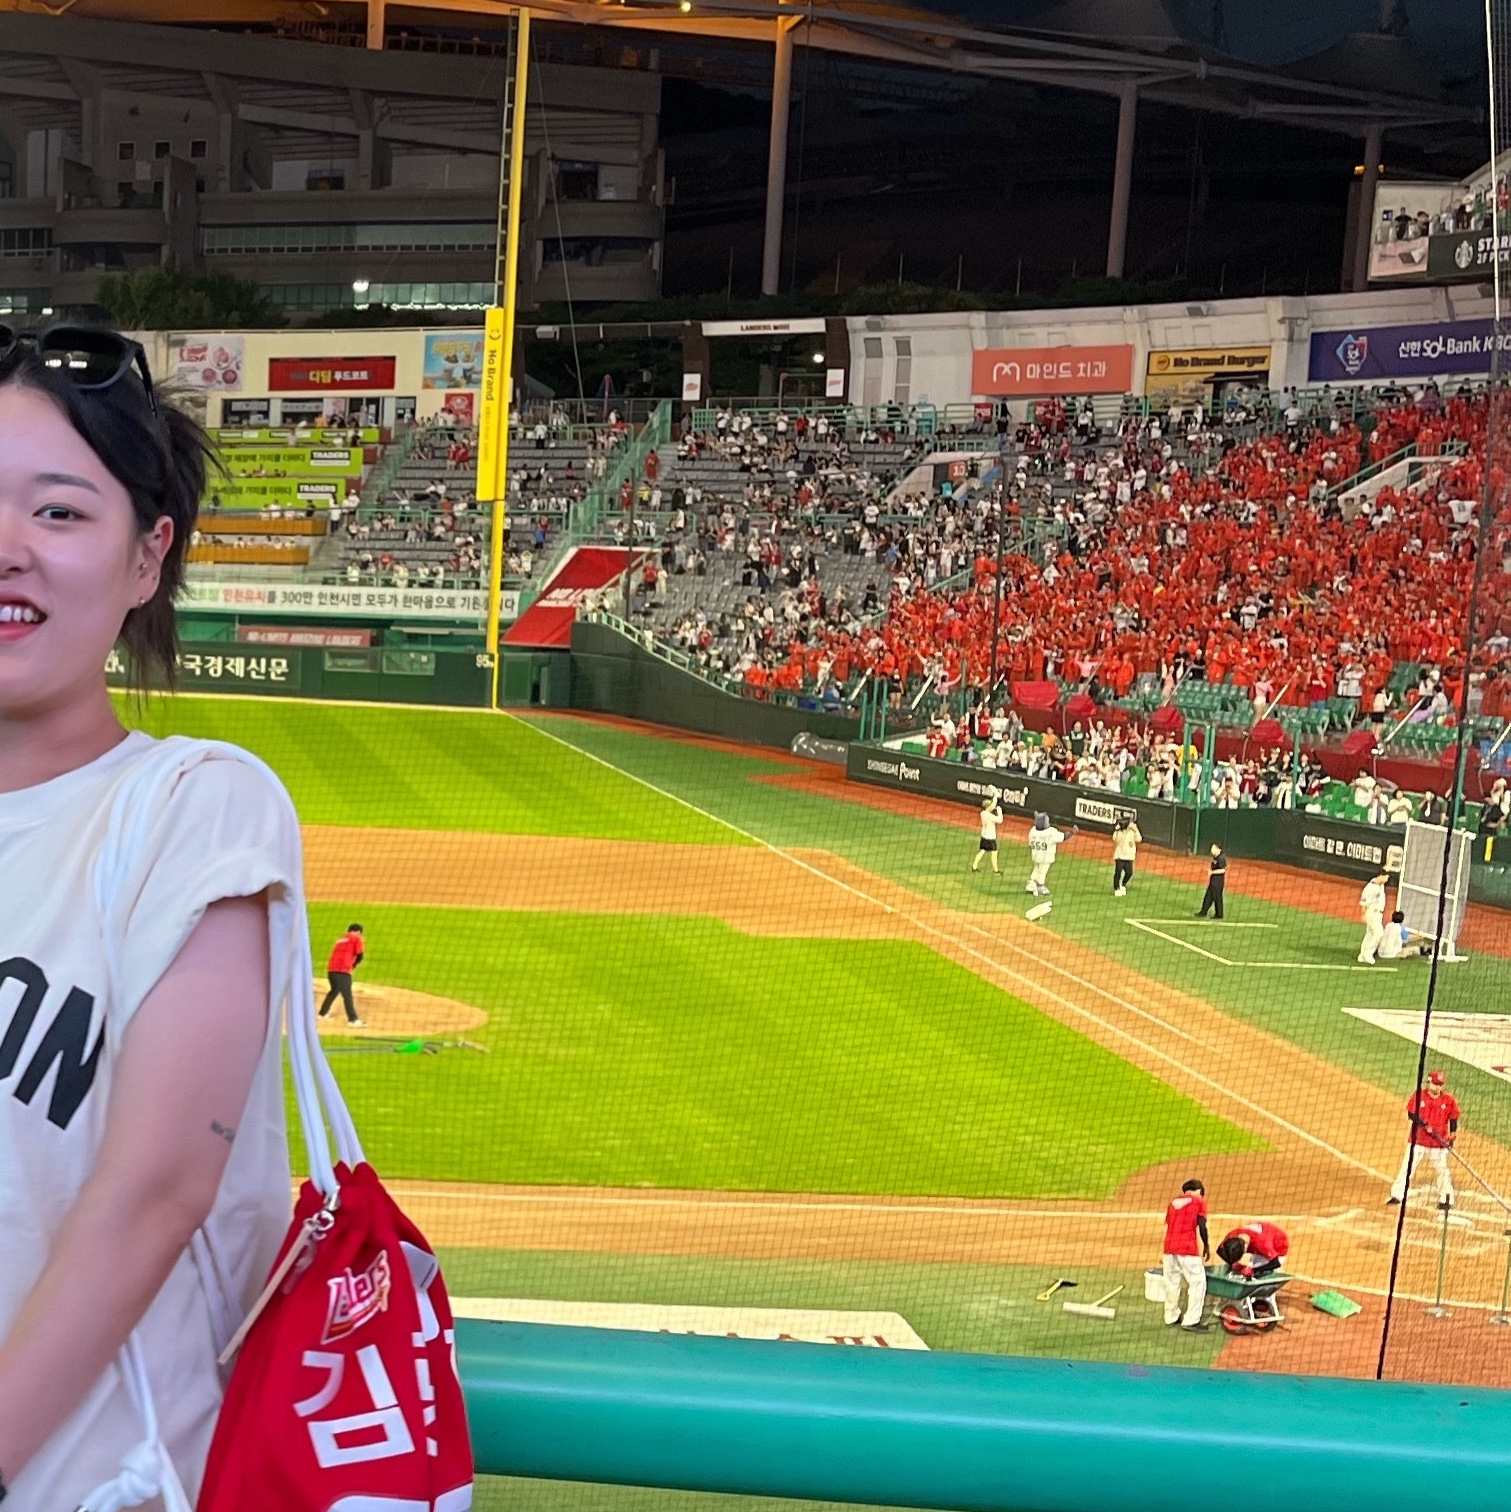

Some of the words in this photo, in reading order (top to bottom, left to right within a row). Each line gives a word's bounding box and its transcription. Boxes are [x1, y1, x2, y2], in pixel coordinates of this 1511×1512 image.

[1399, 341, 1422, 358] 신한
[1446, 336, 1481, 355] Bank
[1026, 361, 1072, 380] 마인드
[1076, 361, 1108, 379] 치과
[312, 451, 350, 460] TRADERS
[299, 484, 337, 493] TRADERS
[281, 589, 314, 606] 300만
[316, 590, 363, 608] 인천시민
[366, 591, 399, 609] 모두가
[401, 592, 456, 610] 한마음으로
[176, 654, 289, 681] 국경제신문
[1078, 802, 1112, 819] TRADERS
